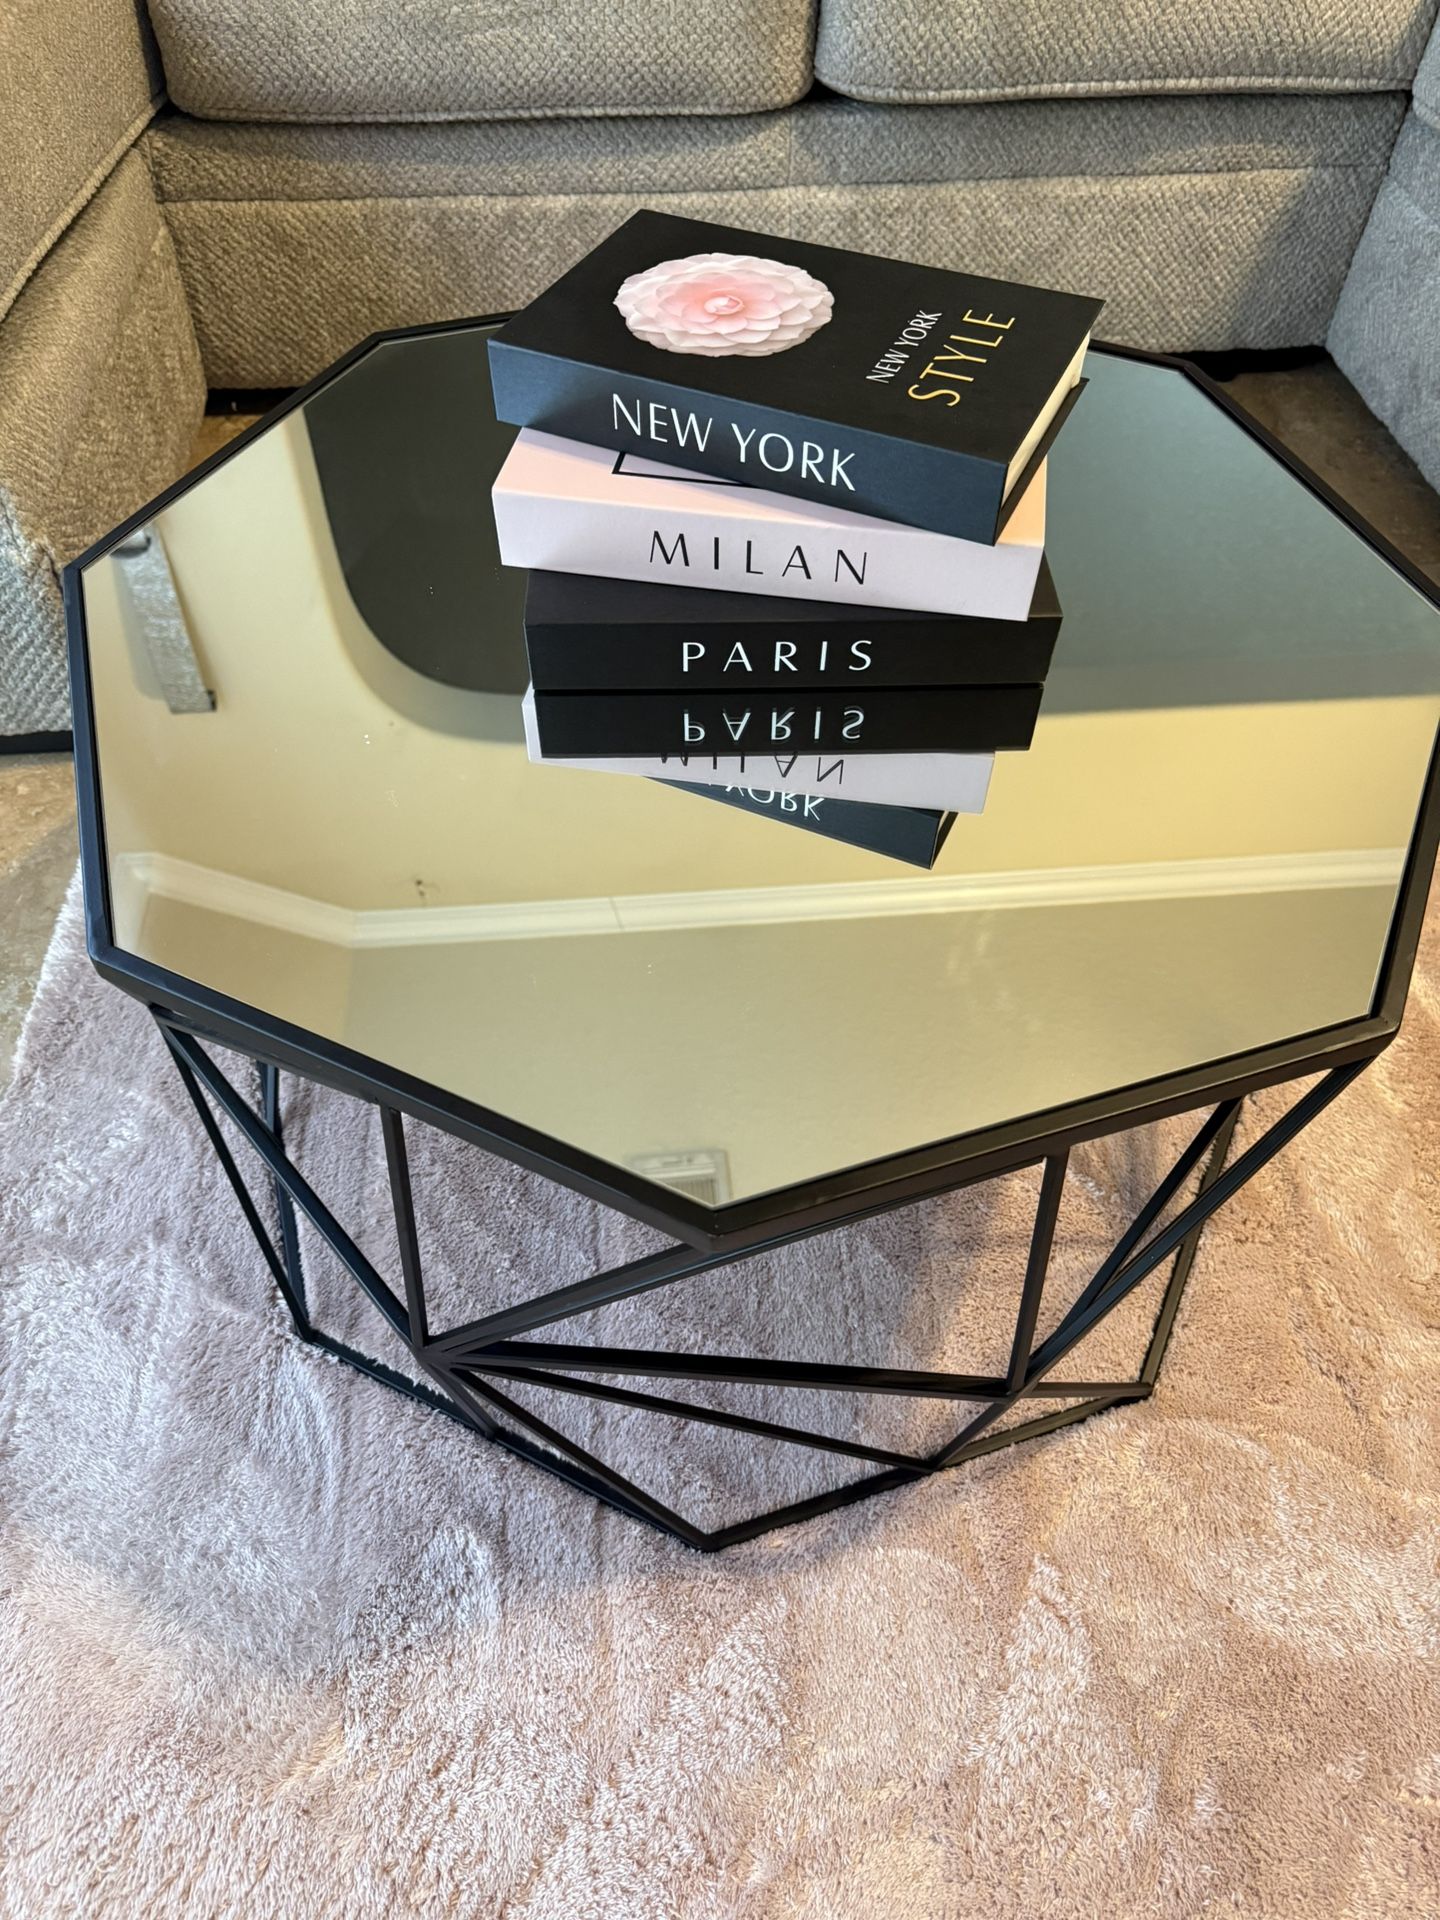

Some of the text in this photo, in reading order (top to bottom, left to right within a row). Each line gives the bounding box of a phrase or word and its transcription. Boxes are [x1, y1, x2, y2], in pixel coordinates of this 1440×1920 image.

[866, 310, 942, 384] NEW YORK
[908, 309, 1015, 406] STYLE
[613, 393, 856, 491] NEW YORK
[650, 530, 867, 585] MILAN
[682, 640, 872, 672] PARIS
